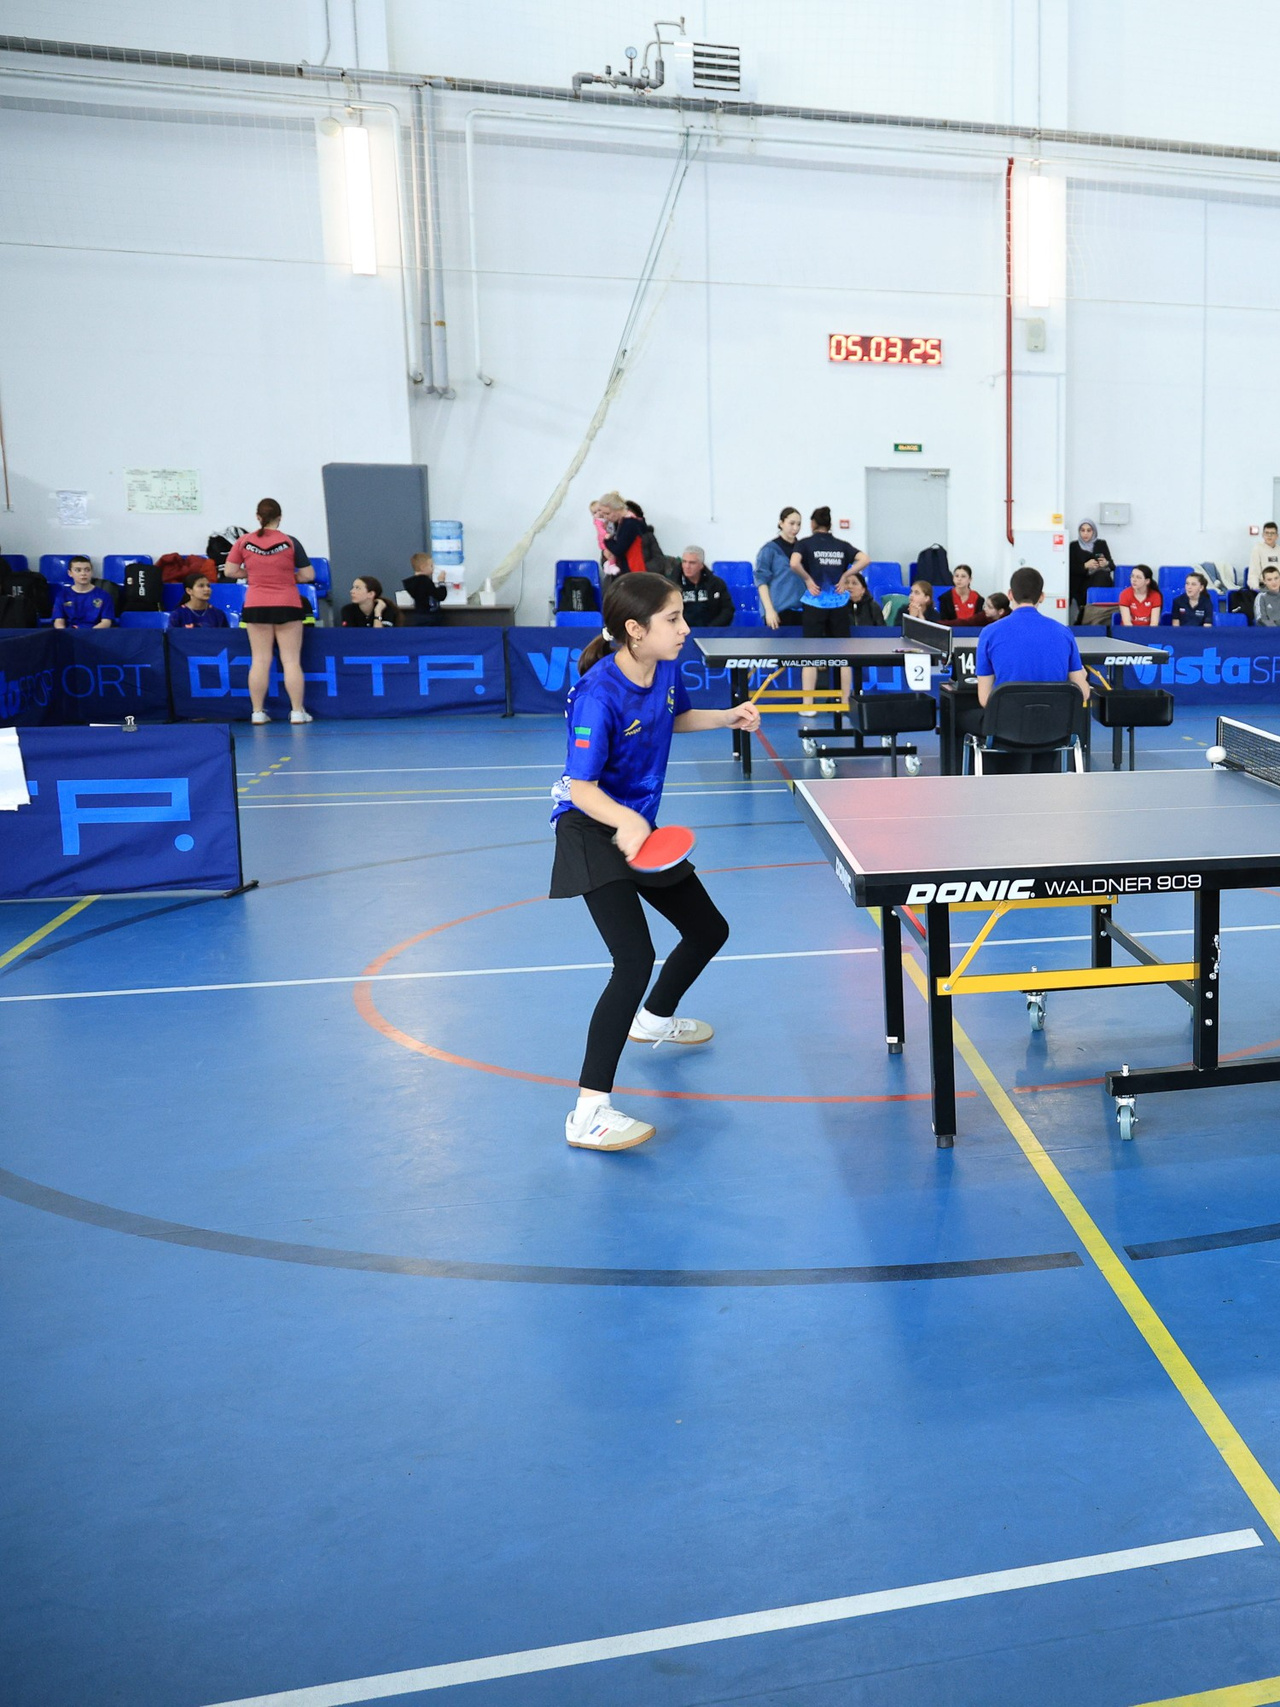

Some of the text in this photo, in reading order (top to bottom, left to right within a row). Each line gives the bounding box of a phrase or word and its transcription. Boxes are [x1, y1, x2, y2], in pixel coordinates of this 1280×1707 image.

[830, 334, 942, 365] 05.03.25
[725, 658, 849, 669] DONIC WALDNER 909
[1104, 655, 1153, 666] DONIC
[914, 665, 925, 682] 2
[906, 874, 1202, 905] DONIC WALDNER 909
